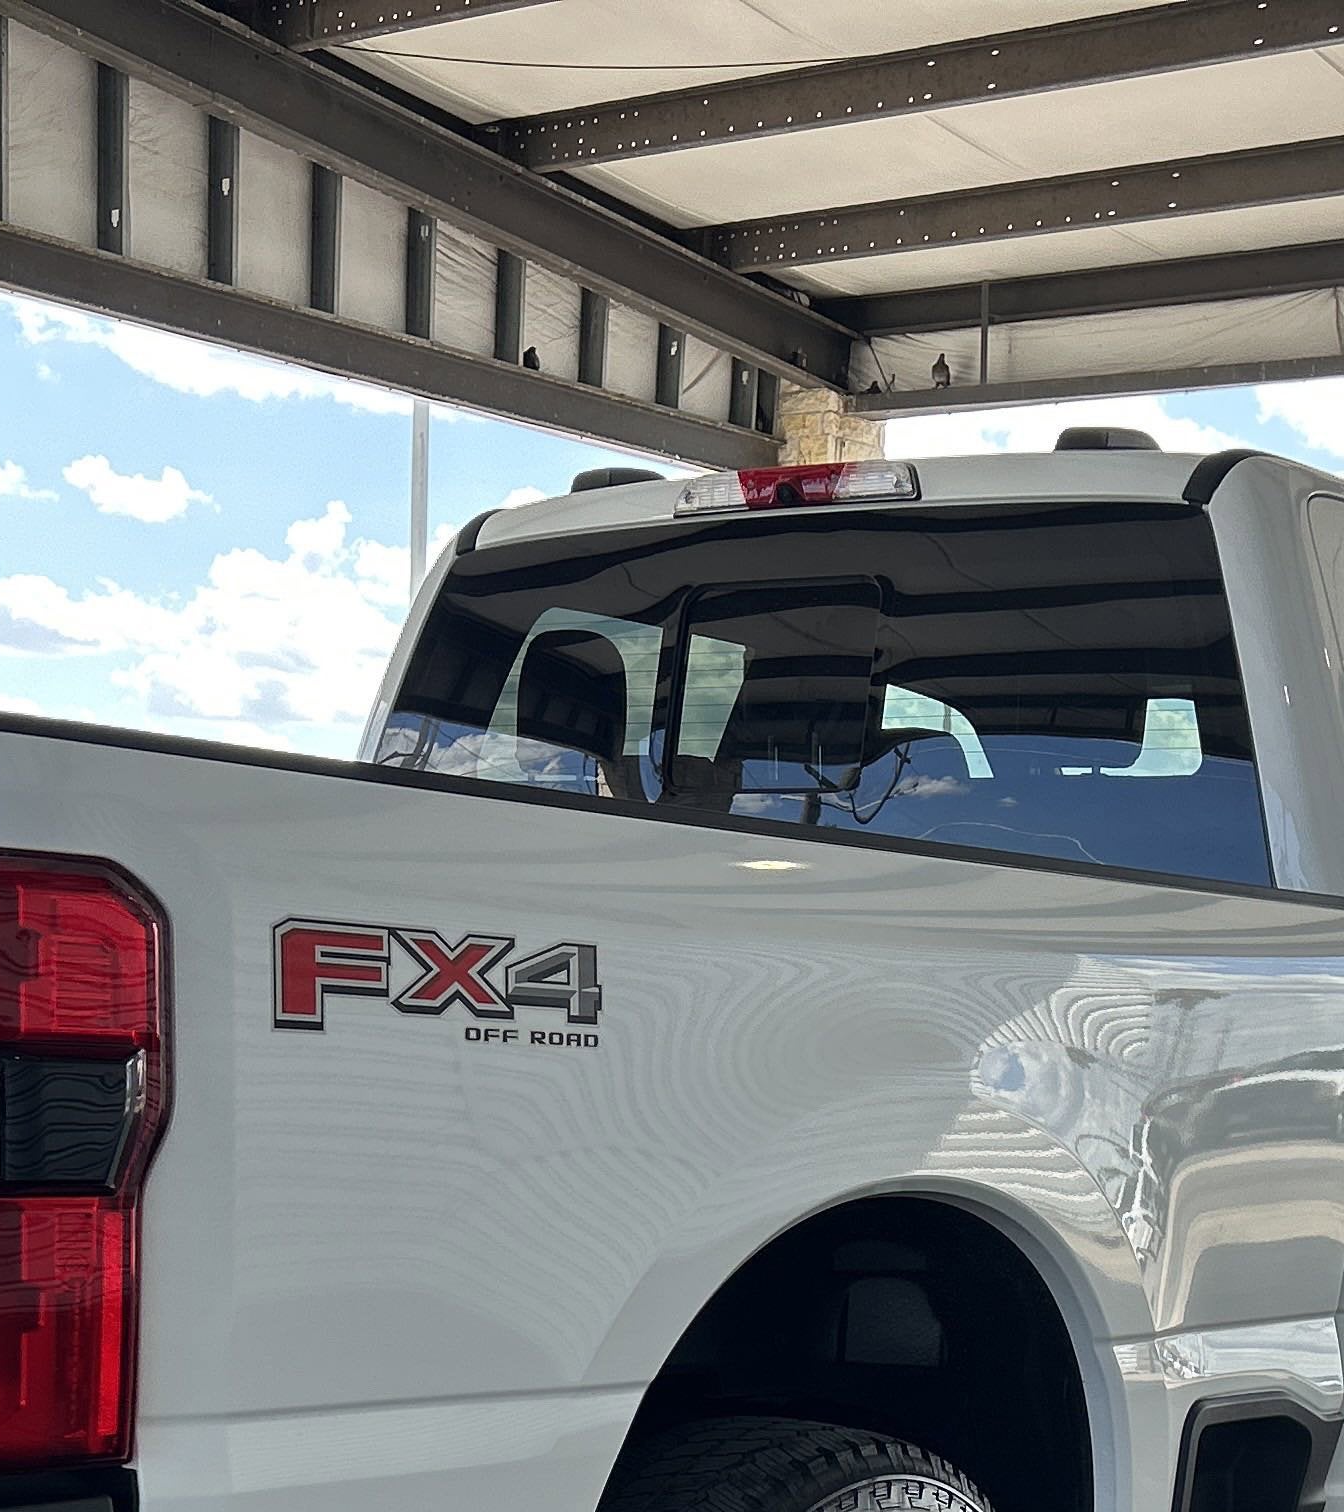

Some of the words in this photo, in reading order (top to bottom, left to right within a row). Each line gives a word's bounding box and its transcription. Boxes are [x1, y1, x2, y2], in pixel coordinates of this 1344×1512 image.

[271, 914, 603, 1031] FX4
[464, 1026, 519, 1043] OFF
[529, 1030, 599, 1048] ROAD
